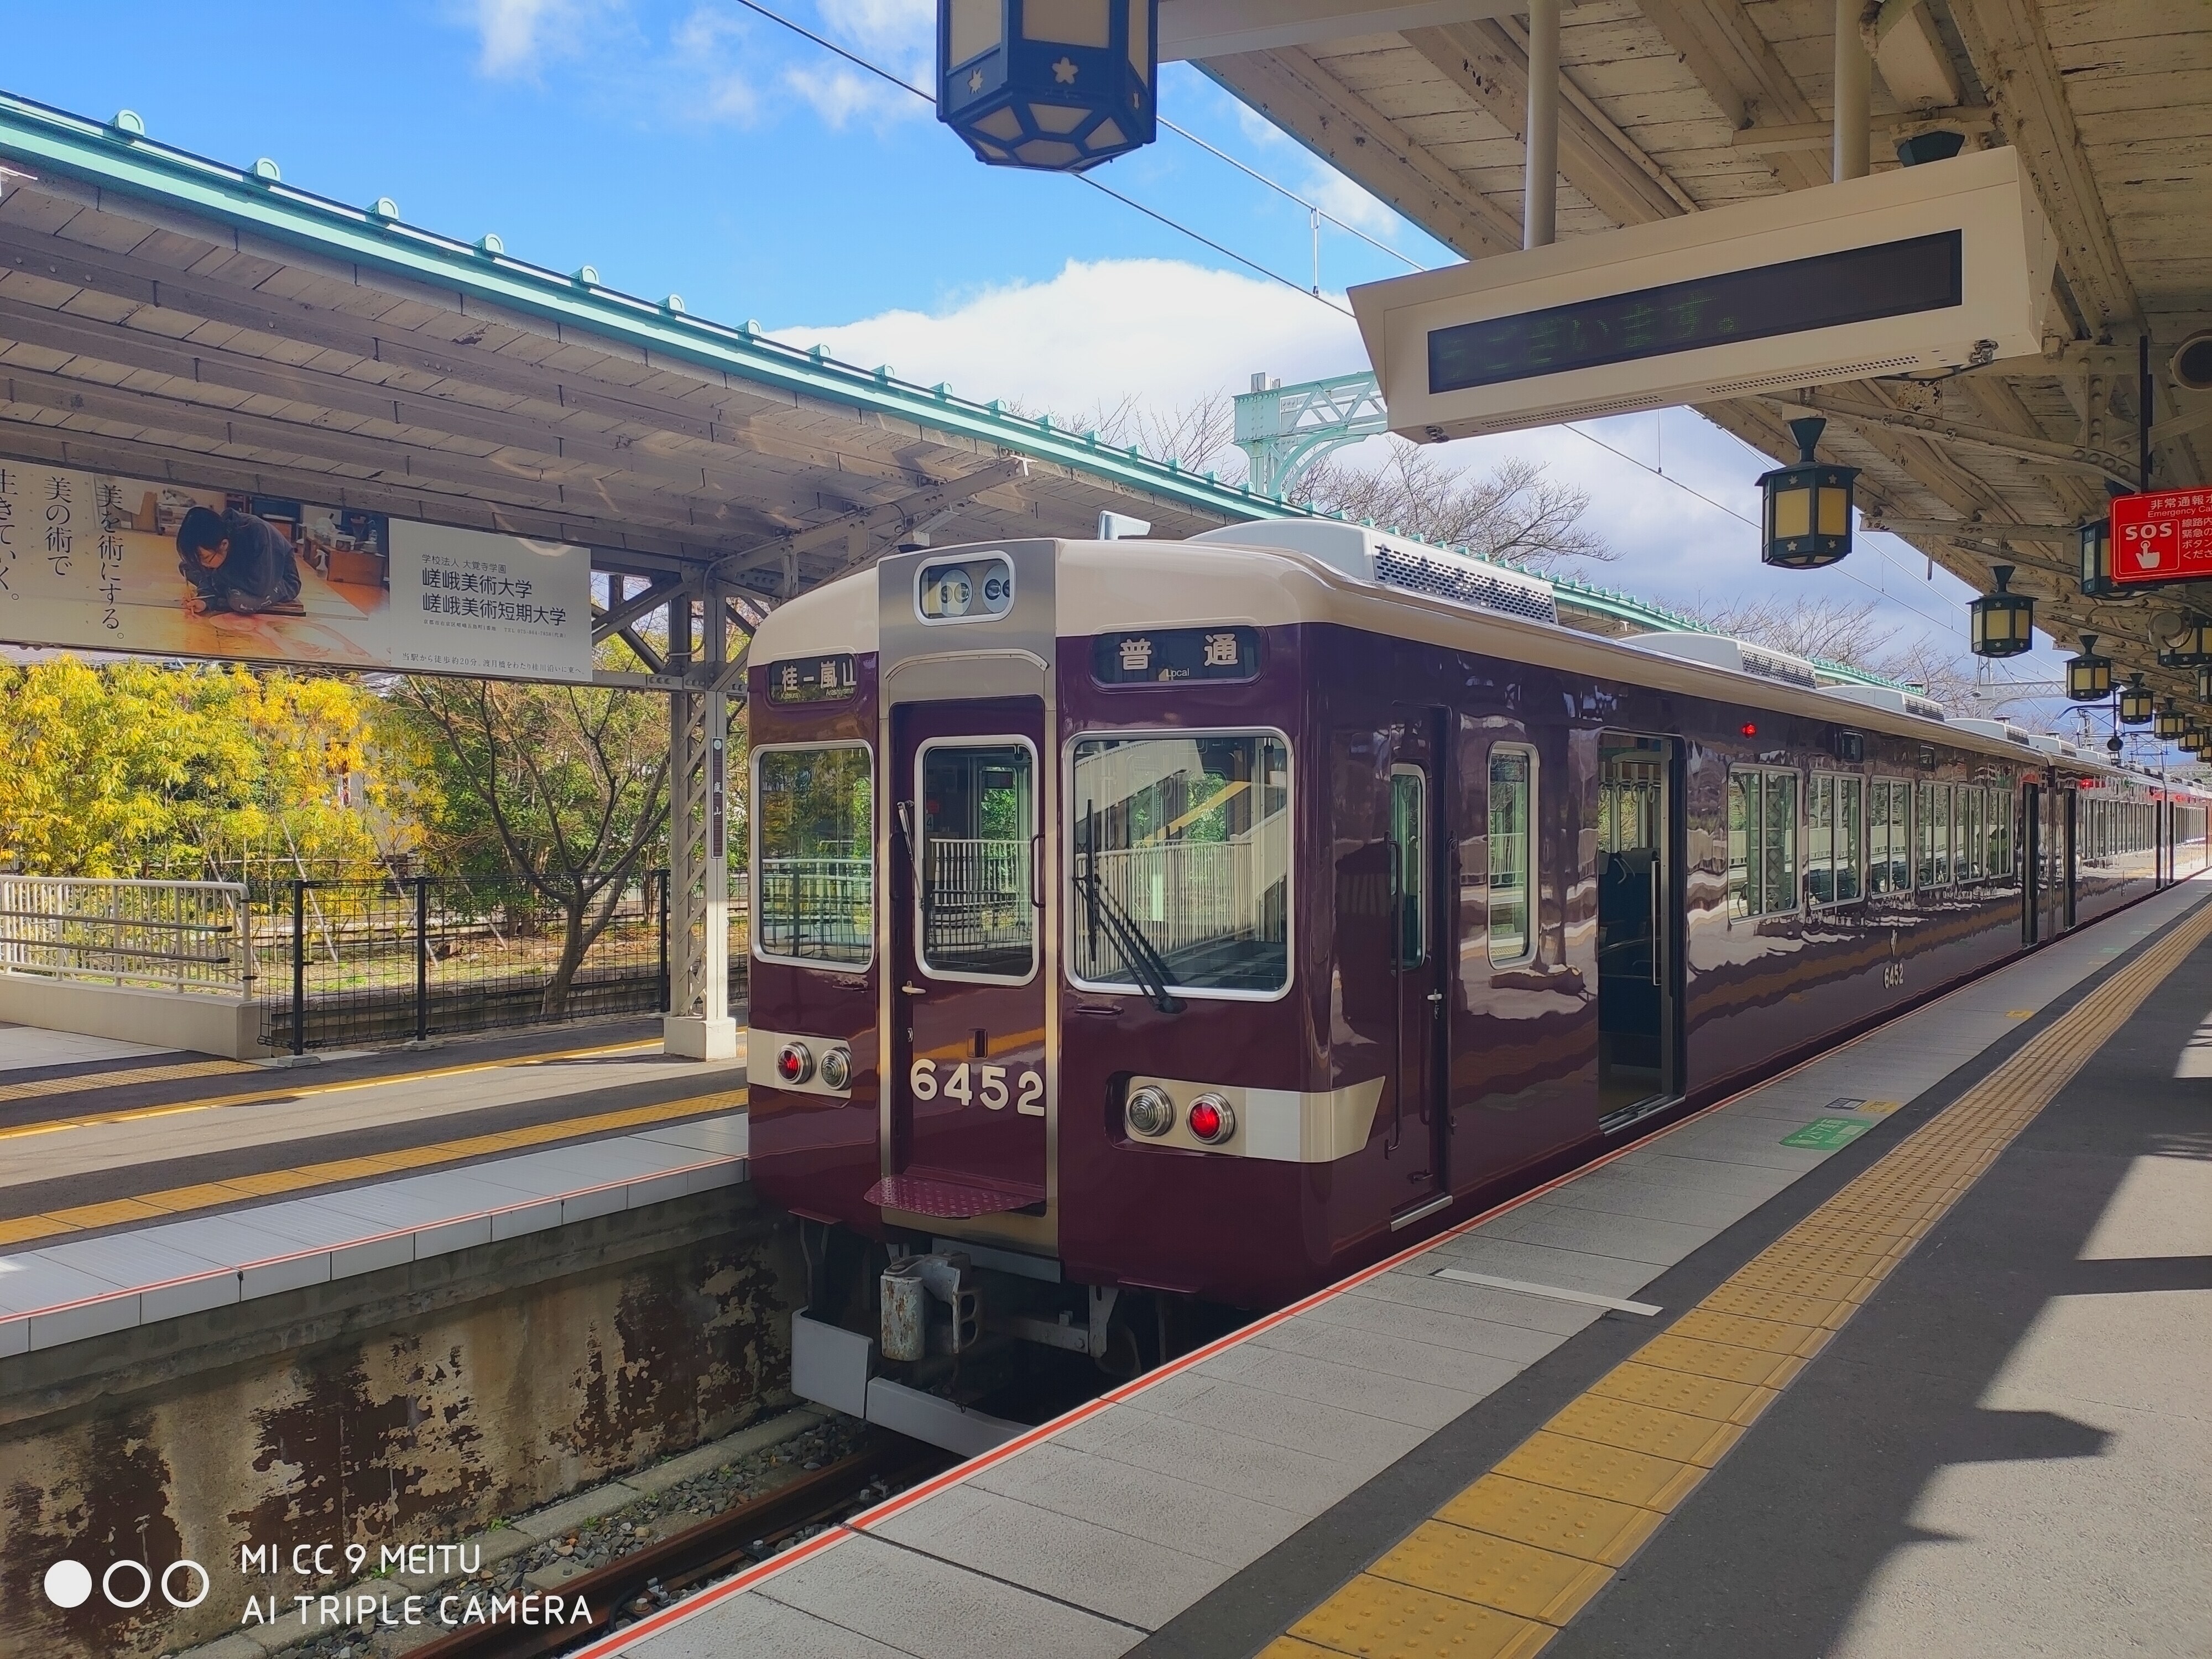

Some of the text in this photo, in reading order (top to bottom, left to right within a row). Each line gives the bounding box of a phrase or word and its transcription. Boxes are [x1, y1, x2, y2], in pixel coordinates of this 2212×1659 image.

[2147, 508, 2196, 518] Emergency
[44, 476, 72, 576] 美の術で
[2182, 517, 2212, 528] 線路内
[2125, 523, 2172, 540] SOS
[2182, 528, 2212, 539] 緊急の
[2182, 539, 2212, 549] ボタン
[96, 483, 124, 640] 美を術にする。
[422, 554, 460, 567] 学校法人
[2183, 549, 2212, 560] くださ
[422, 567, 533, 599] 嵯峨美術大学
[422, 592, 566, 626] 嵯峨美術短期大学
[1166, 667, 1190, 677] Local
[780, 687, 854, 700] Katsura Arashiyama
[713, 781, 723, 816] 嵐山
[1884, 962, 1904, 990] 6452
[910, 1058, 1045, 1117] 6452
